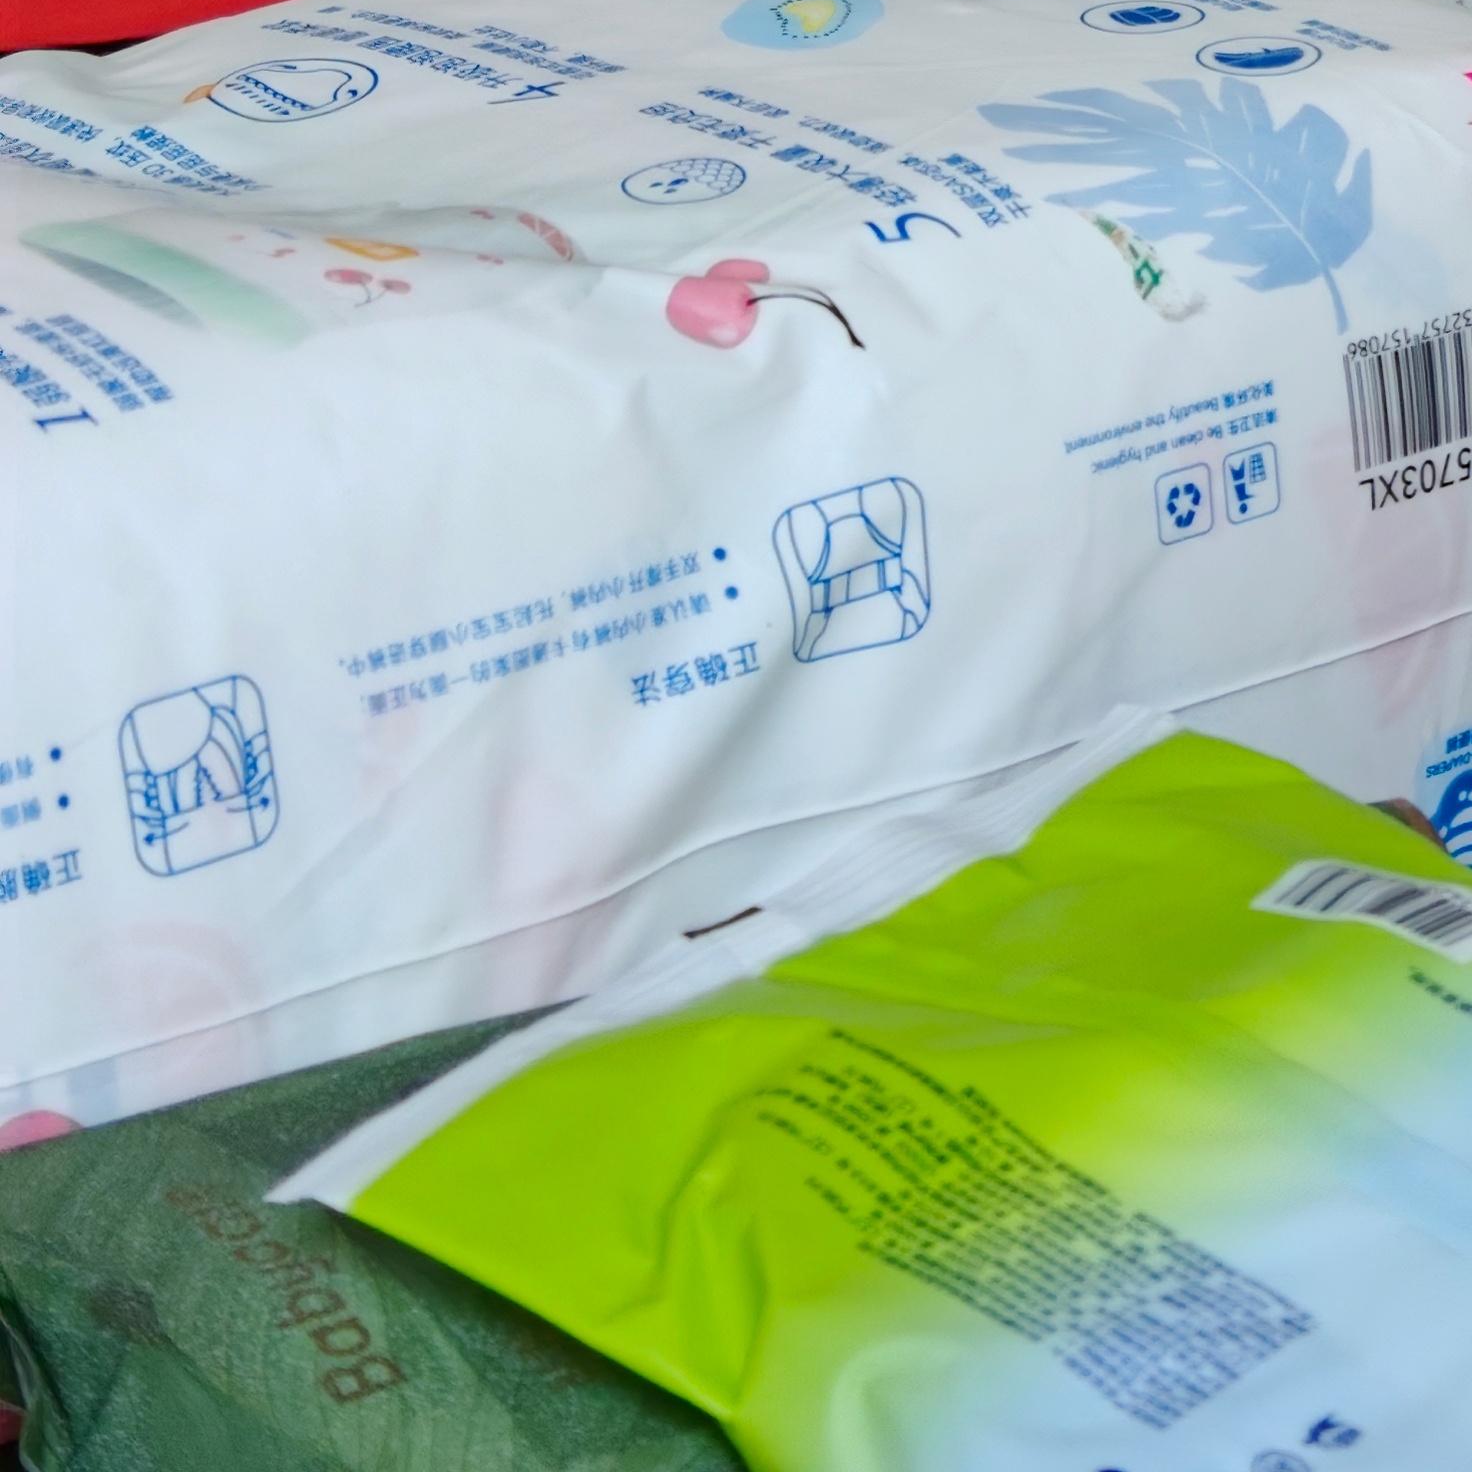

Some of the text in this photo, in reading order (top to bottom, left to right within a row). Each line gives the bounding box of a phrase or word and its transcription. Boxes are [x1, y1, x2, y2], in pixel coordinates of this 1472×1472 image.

[864, 211, 963, 244] 5
[630, 640, 762, 708] 正确穿法
